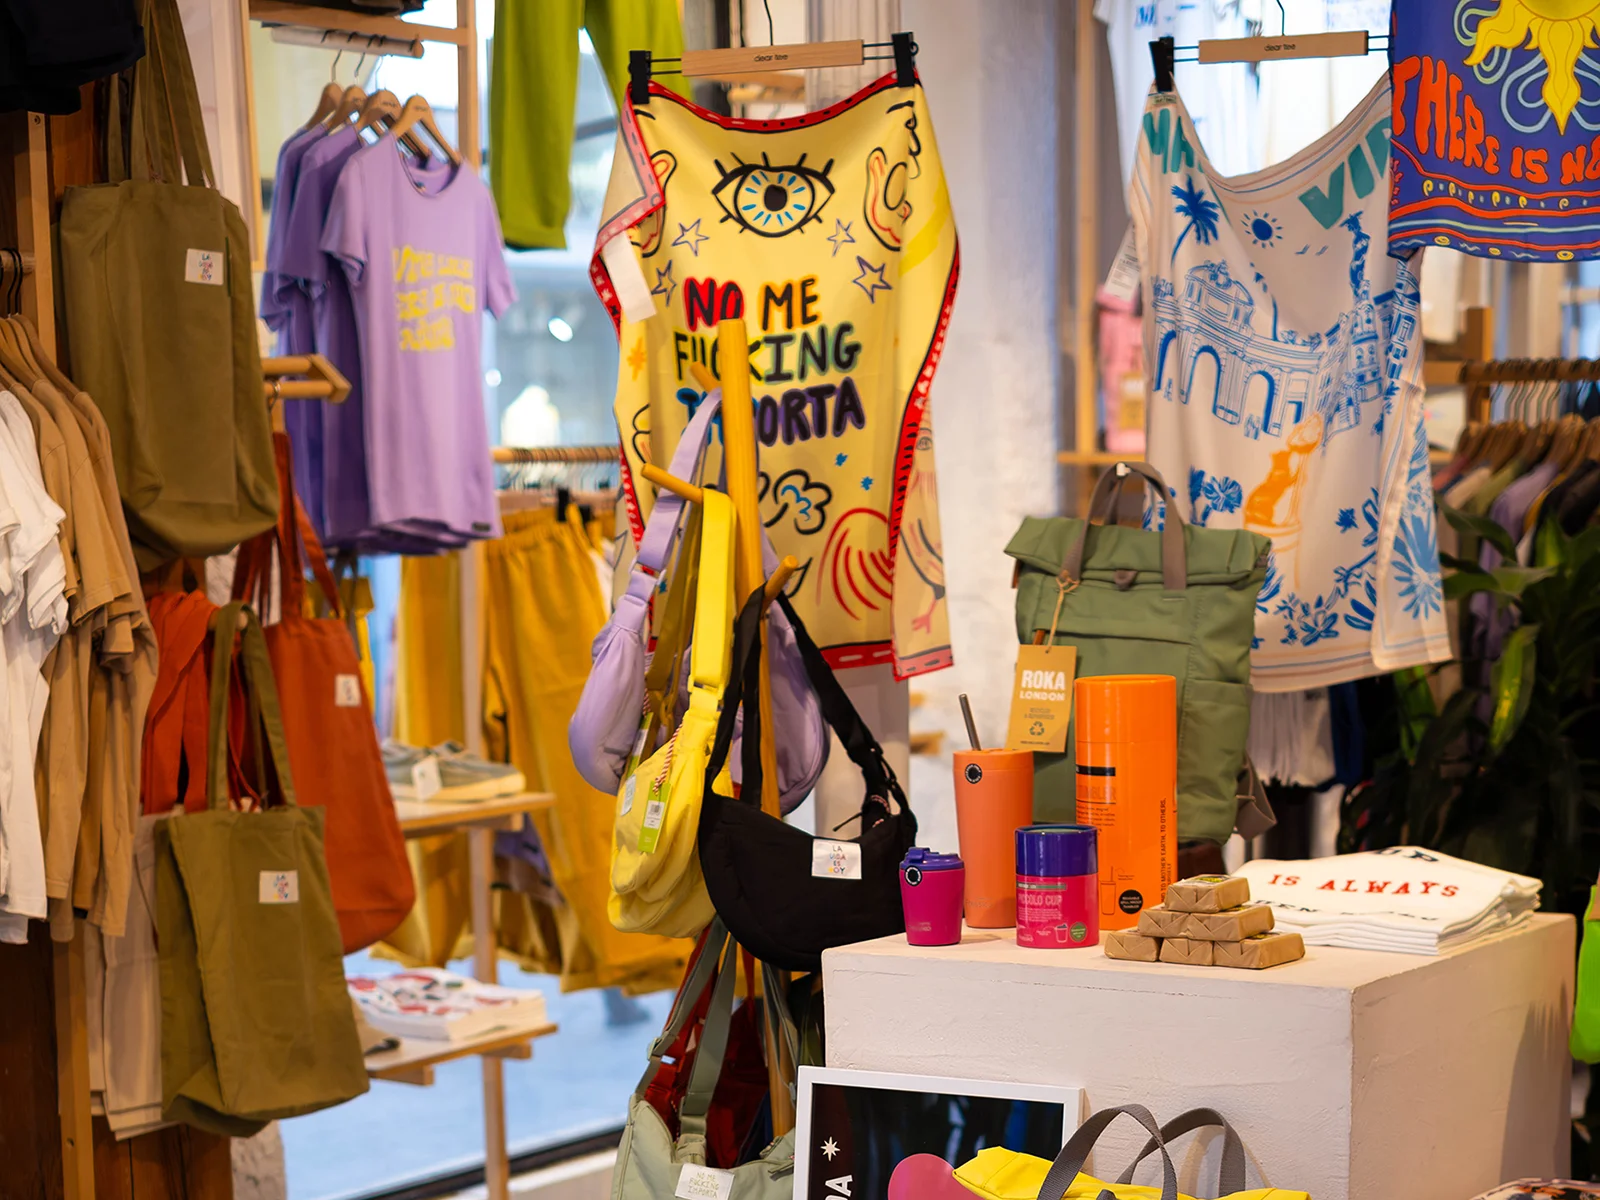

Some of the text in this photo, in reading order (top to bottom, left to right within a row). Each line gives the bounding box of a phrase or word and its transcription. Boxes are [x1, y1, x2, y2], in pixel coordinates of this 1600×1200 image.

[1392, 55, 1500, 175] THERE
[1510, 146, 1549, 184] IS
[686, 277, 818, 331] NO ME
[1021, 669, 1065, 690] ROKA
[1019, 690, 1065, 701] LONDON
[1268, 874, 1460, 897] IS ALWAYS
